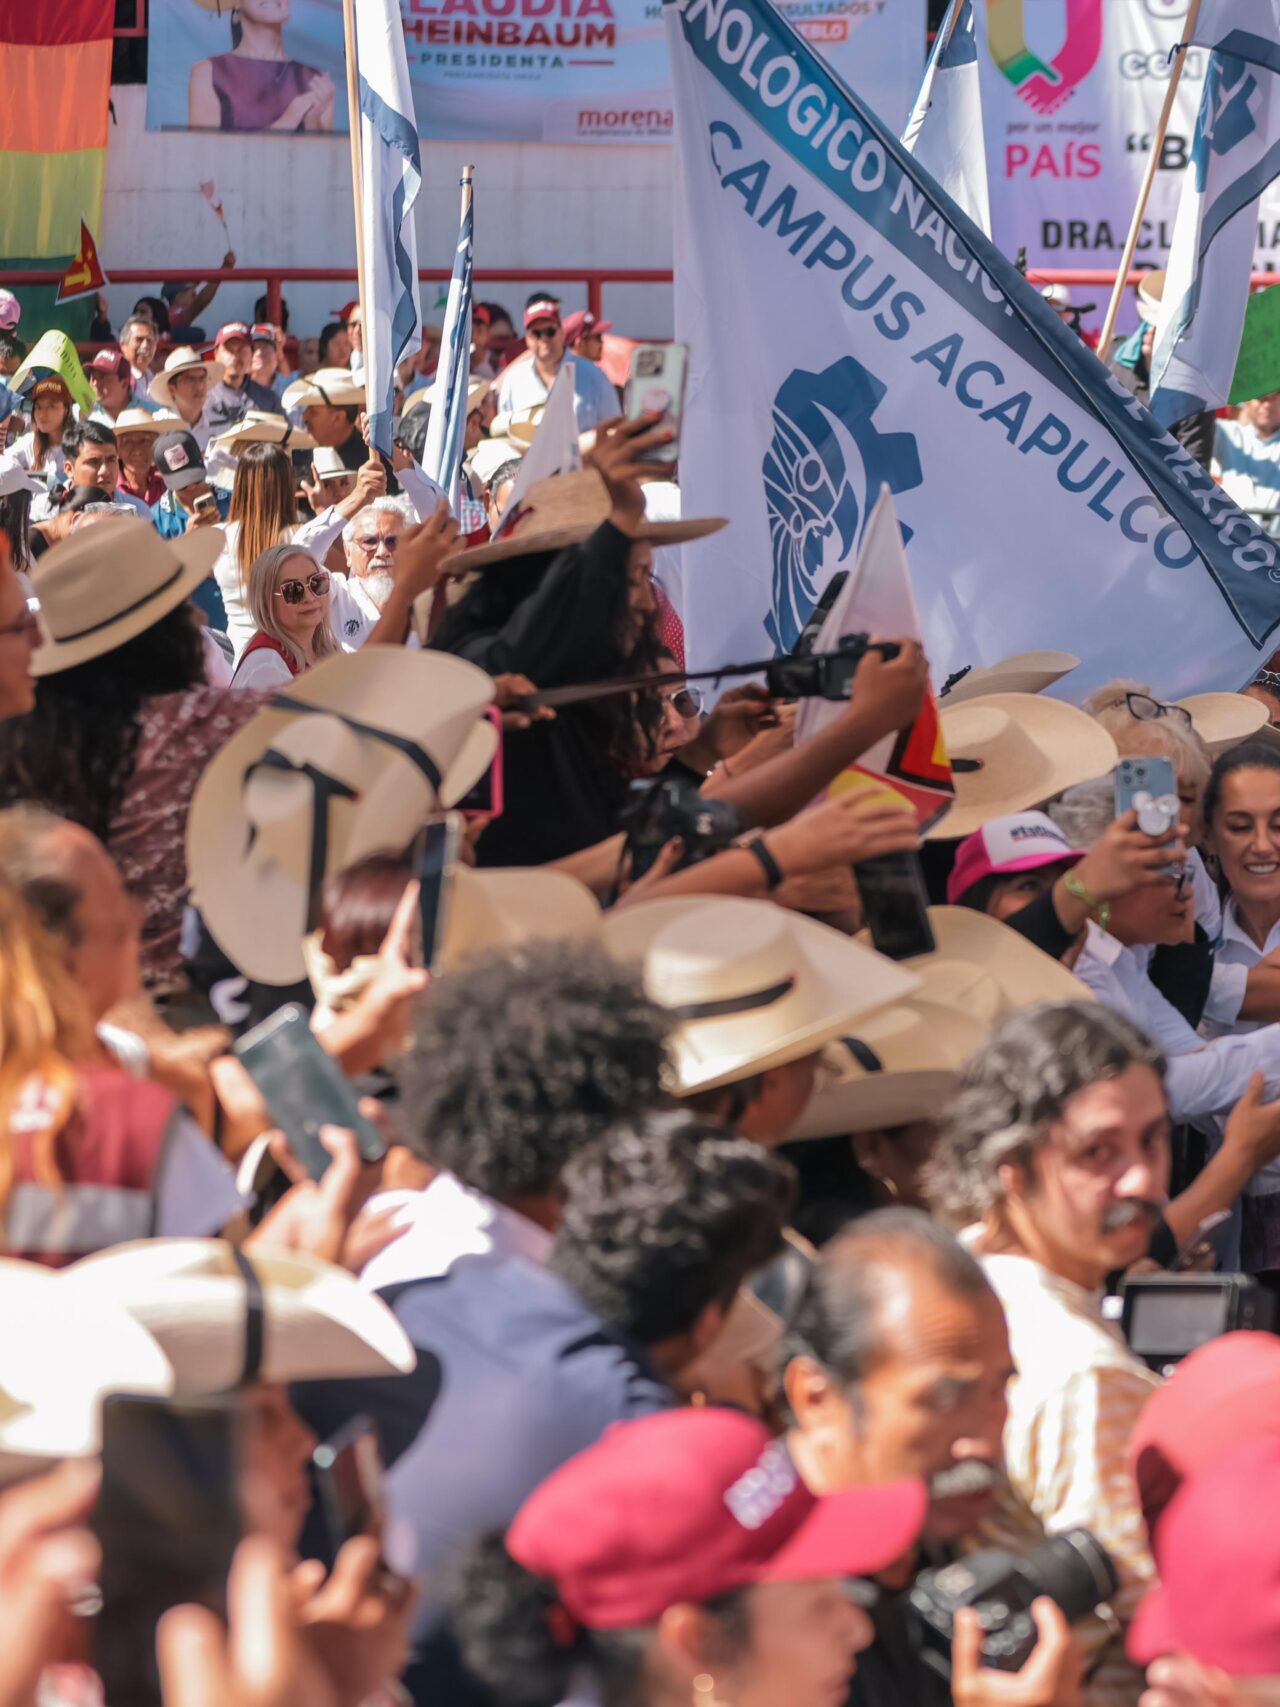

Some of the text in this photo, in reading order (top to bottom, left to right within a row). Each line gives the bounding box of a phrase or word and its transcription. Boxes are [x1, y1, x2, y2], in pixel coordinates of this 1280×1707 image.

[401, 0, 614, 17] LAUDIA
[777, 0, 870, 15] ESULTADOS
[402, 18, 616, 47] HEINBAUM
[420, 52, 564, 69] PRESIDENTA
[684, 0, 888, 192] NOLÓGICO
[578, 109, 673, 129] morena
[706, 120, 926, 341] CAMPUS
[911, 333, 1200, 569] ACAPULCO
